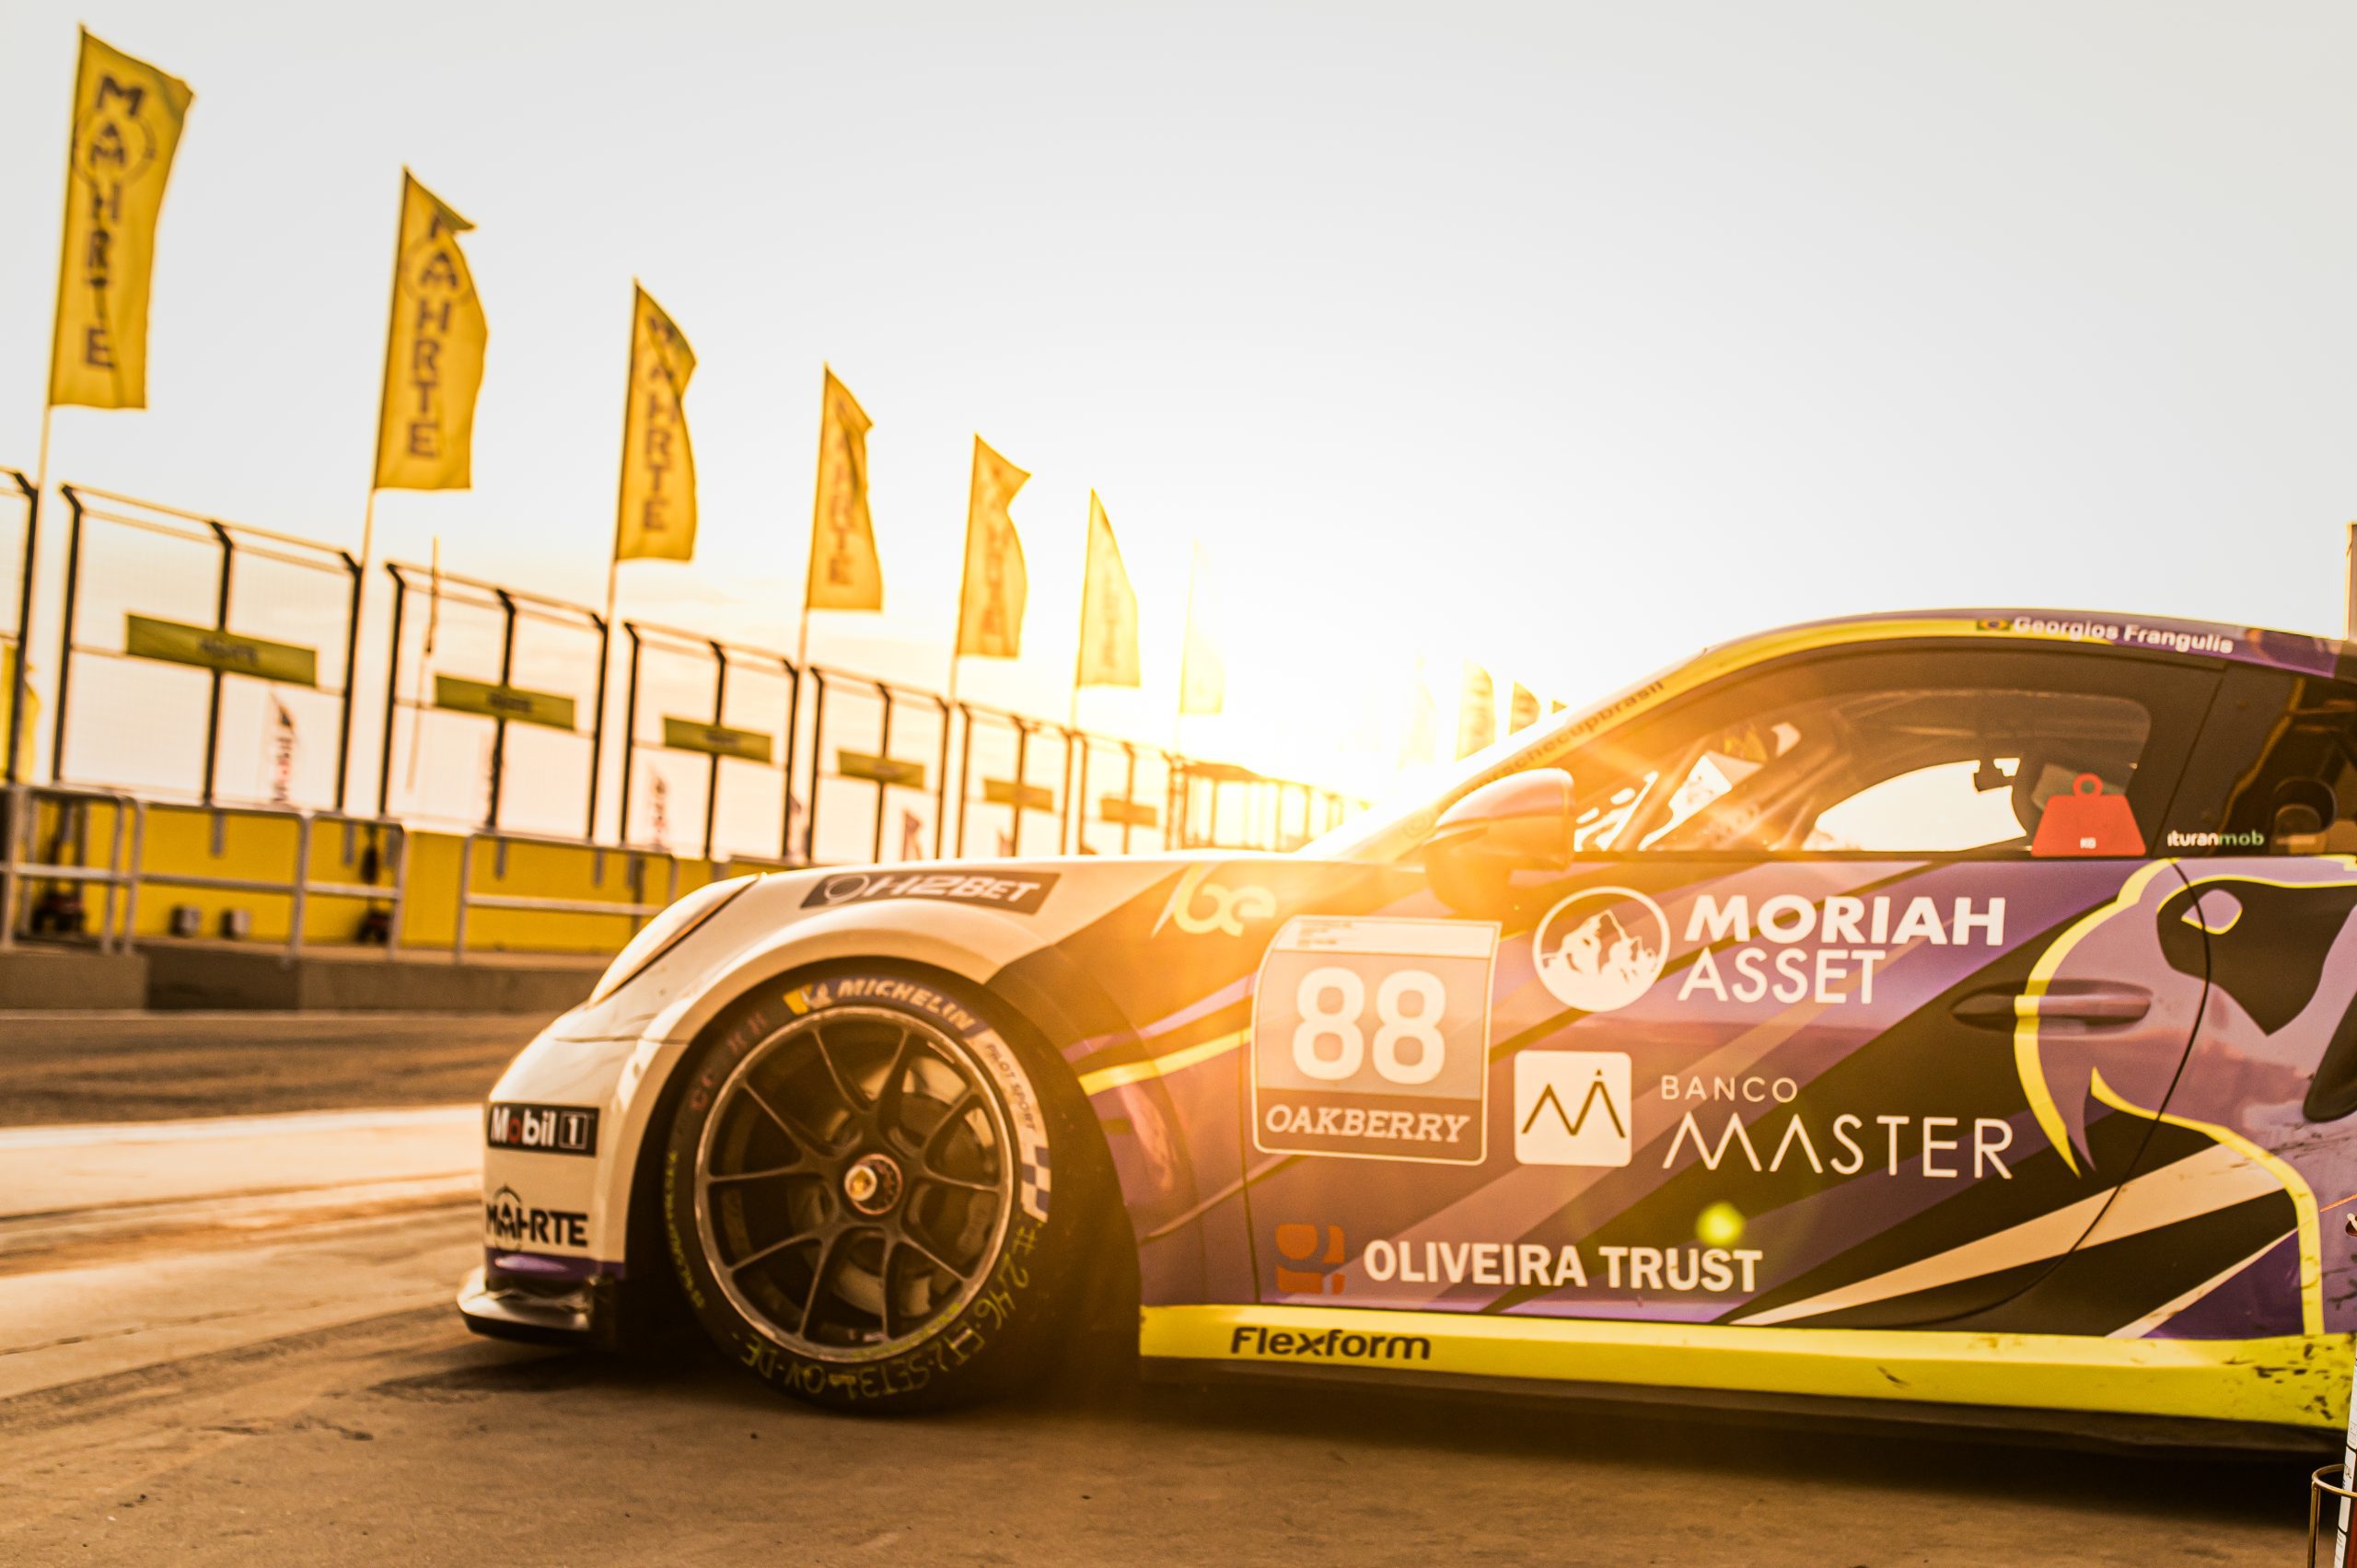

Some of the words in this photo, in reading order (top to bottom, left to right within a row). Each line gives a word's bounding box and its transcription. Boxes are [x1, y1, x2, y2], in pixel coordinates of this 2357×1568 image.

[2014, 616, 2118, 642] Georgios
[2123, 624, 2235, 654] Frangulis
[1684, 894, 2006, 947] MORIAH
[1677, 947, 1887, 1005] ASSET
[836, 978, 977, 1031] MICHELIN
[1292, 966, 1446, 1085] 88
[1661, 1074, 1797, 1103] BANCO
[490, 1105, 557, 1147] Mobil
[1265, 1104, 1470, 1143] OAKBERRY
[1661, 1111, 2014, 1179] MASTER
[1363, 1238, 1587, 1288] OLIVEIRA
[1598, 1246, 1763, 1293] TRUST
[1230, 1326, 1432, 1360] Flexform
